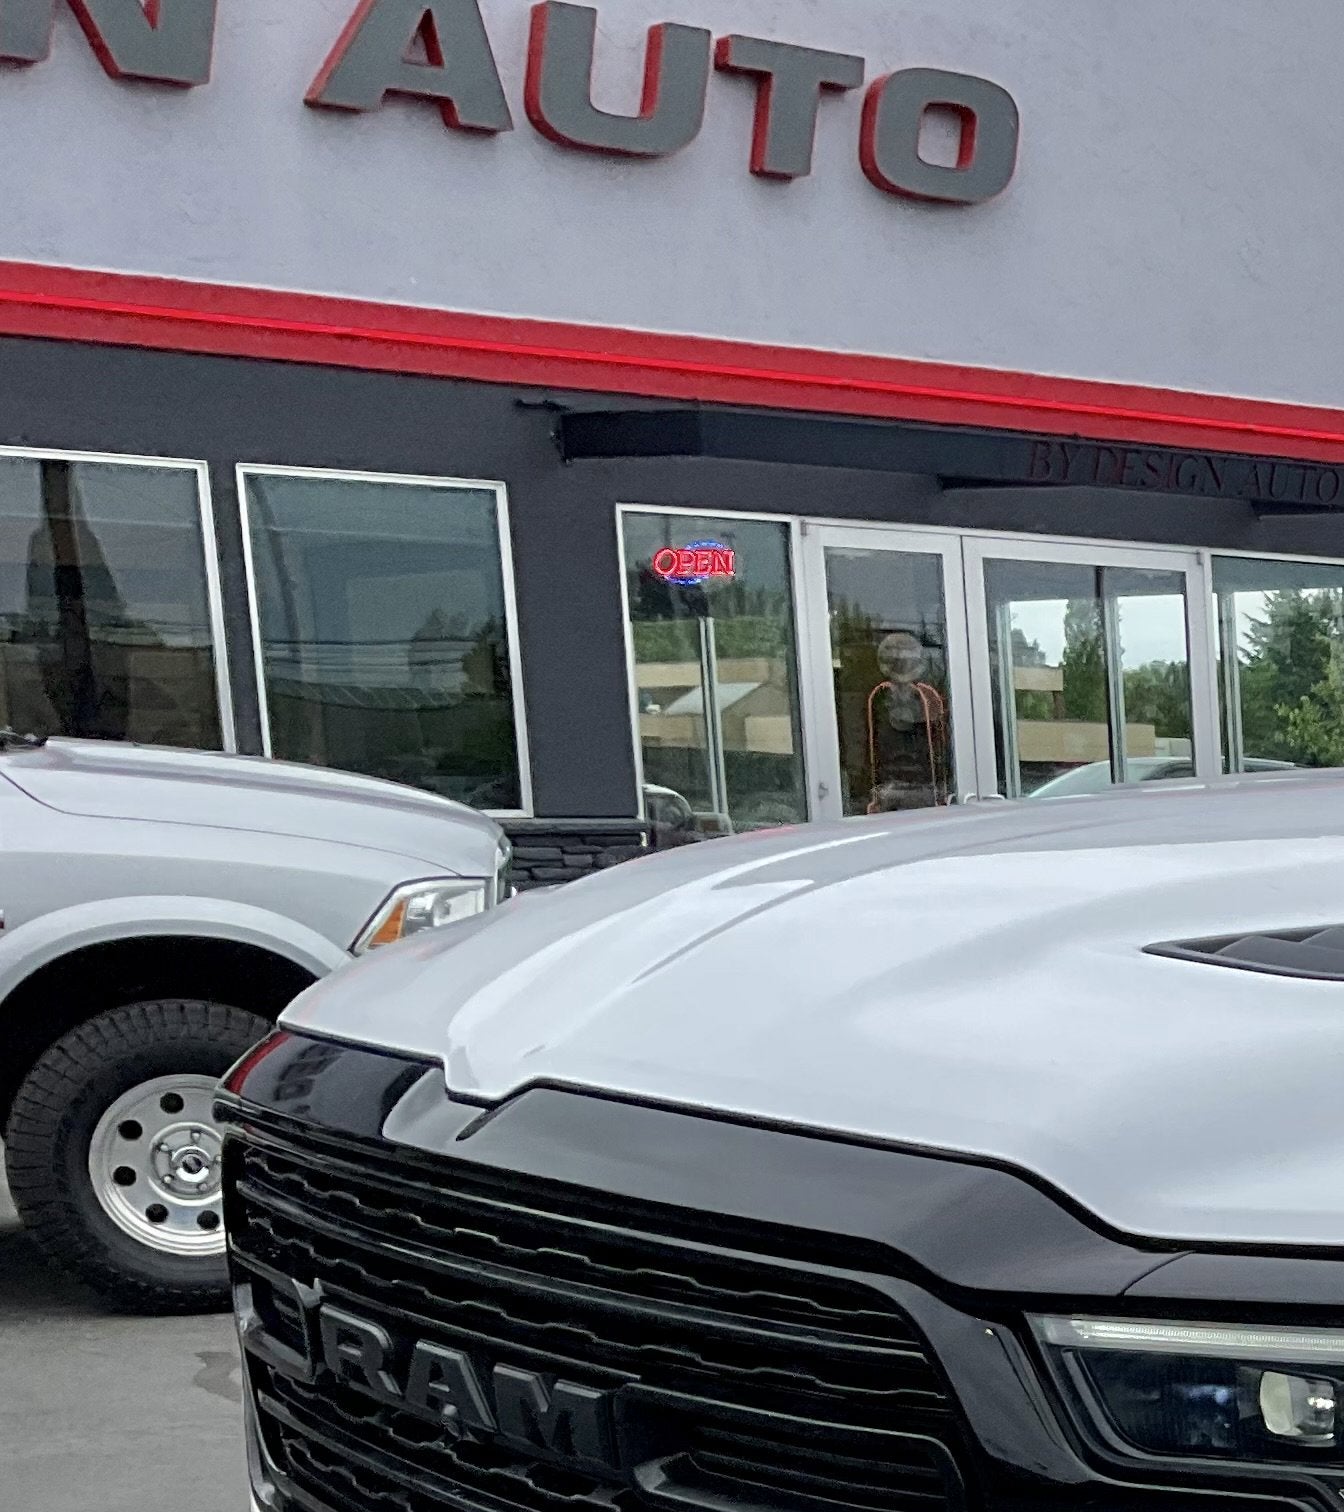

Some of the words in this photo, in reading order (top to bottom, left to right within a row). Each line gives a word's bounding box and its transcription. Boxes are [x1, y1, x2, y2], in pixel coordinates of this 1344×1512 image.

[304, 0, 1021, 203] AUTO
[1027, 440, 1077, 481] BY
[1092, 446, 1230, 493] DESIGN
[1236, 461, 1341, 502] AUTO
[653, 548, 735, 577] OPEN
[319, 1301, 613, 1466] RAM
